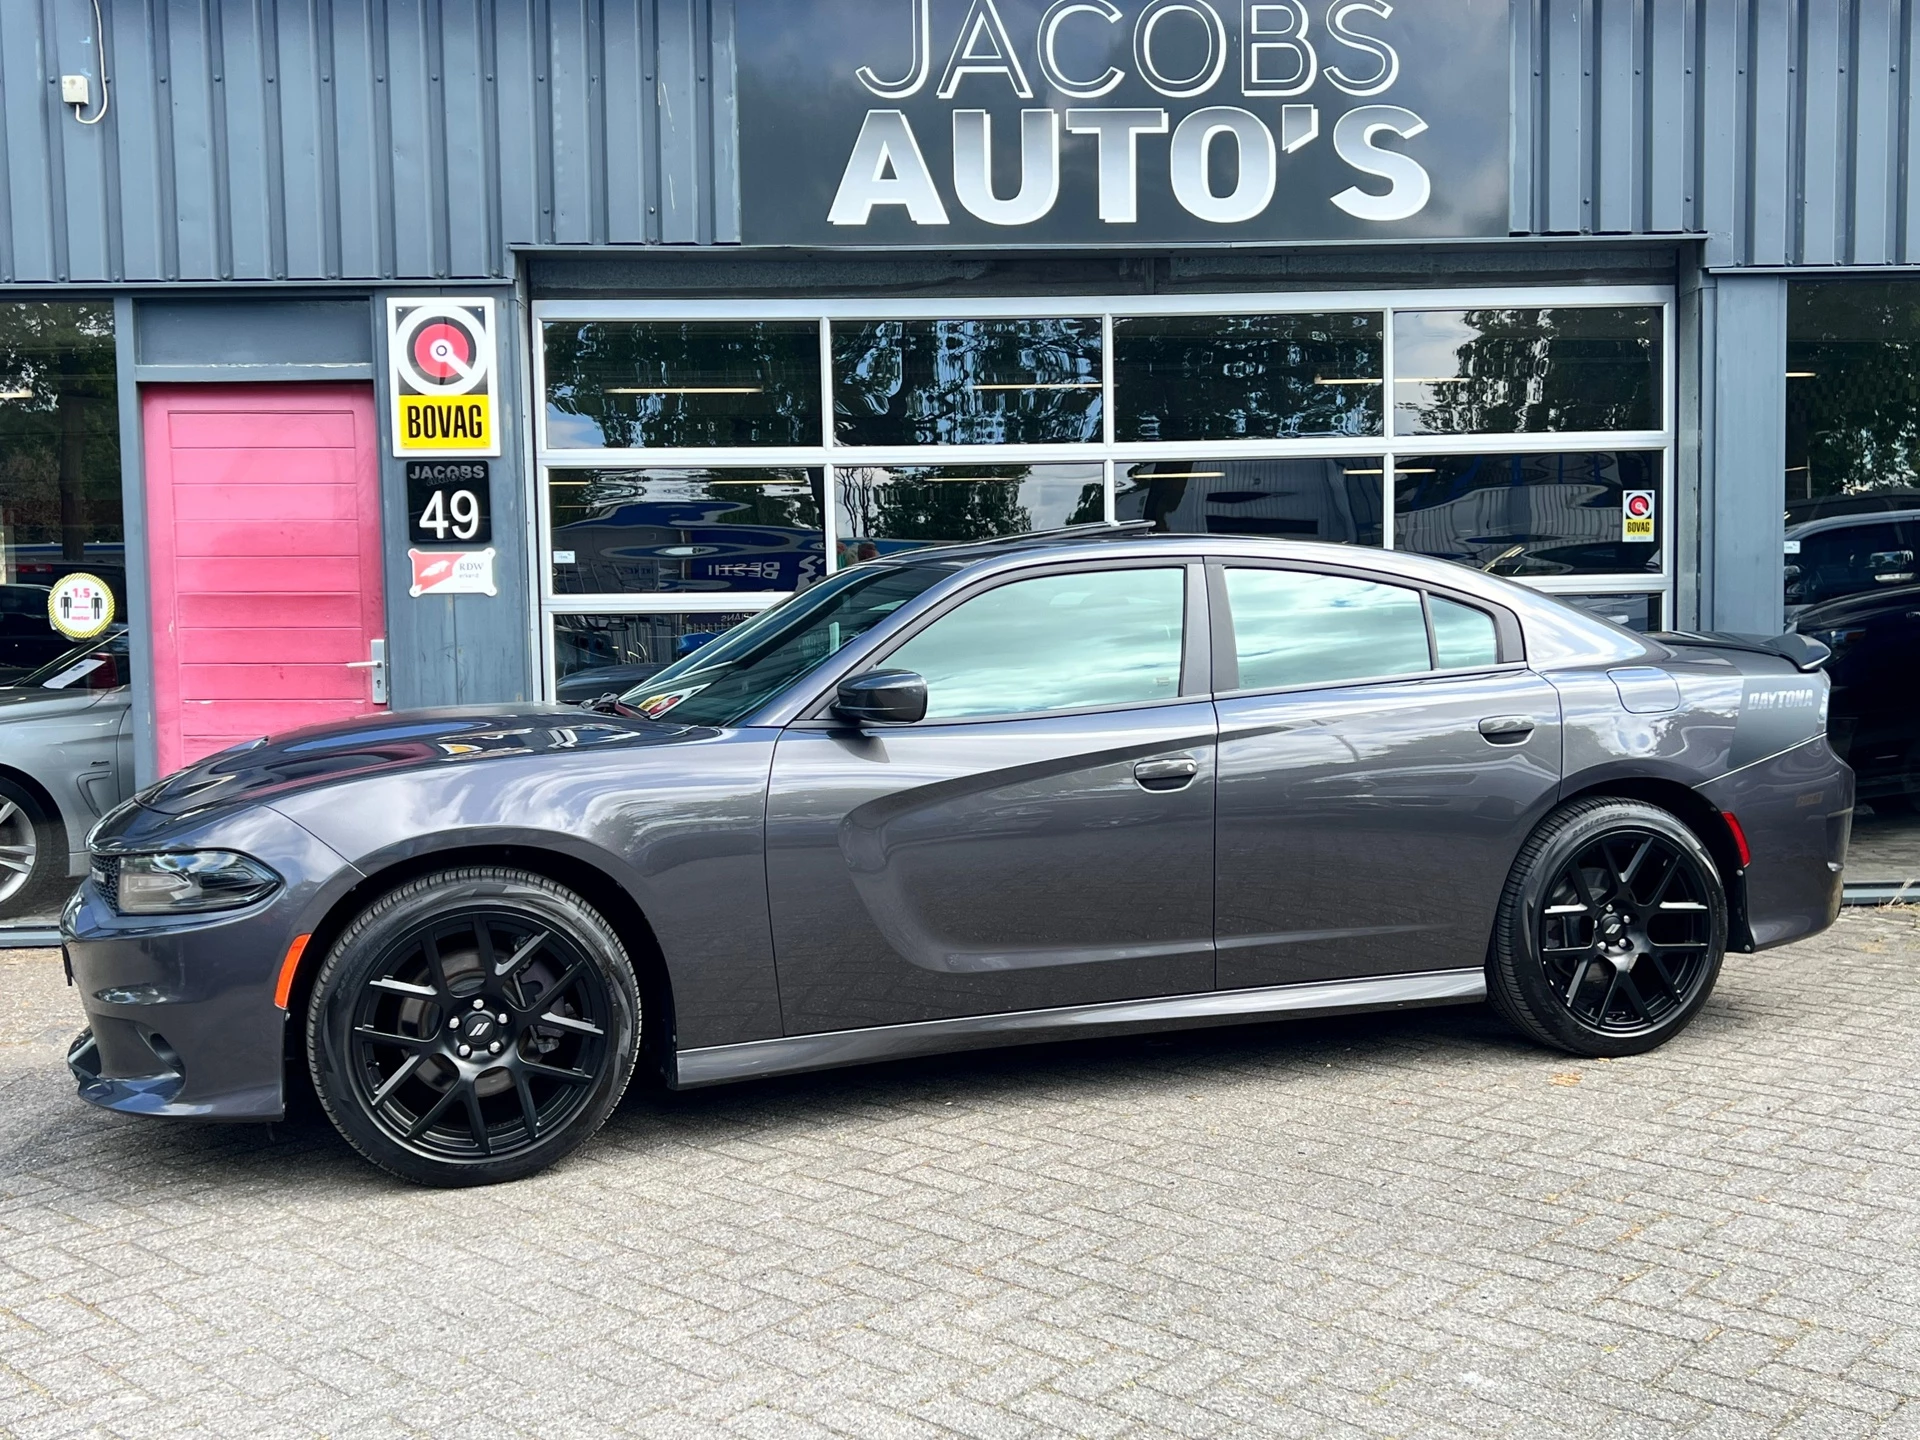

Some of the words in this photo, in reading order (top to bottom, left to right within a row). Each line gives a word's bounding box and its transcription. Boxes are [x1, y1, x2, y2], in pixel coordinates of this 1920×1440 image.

[855, 0, 1401, 99] JACOBS
[826, 104, 1431, 226] AUTO'S
[407, 404, 483, 440] BOVAG
[409, 465, 485, 480] JACOBS
[419, 489, 479, 540] 49
[1627, 521, 1650, 533] BOVAG
[459, 562, 484, 571] RDW
[72, 587, 91, 599] 1.5
[1747, 689, 1814, 711] DAYTONA
